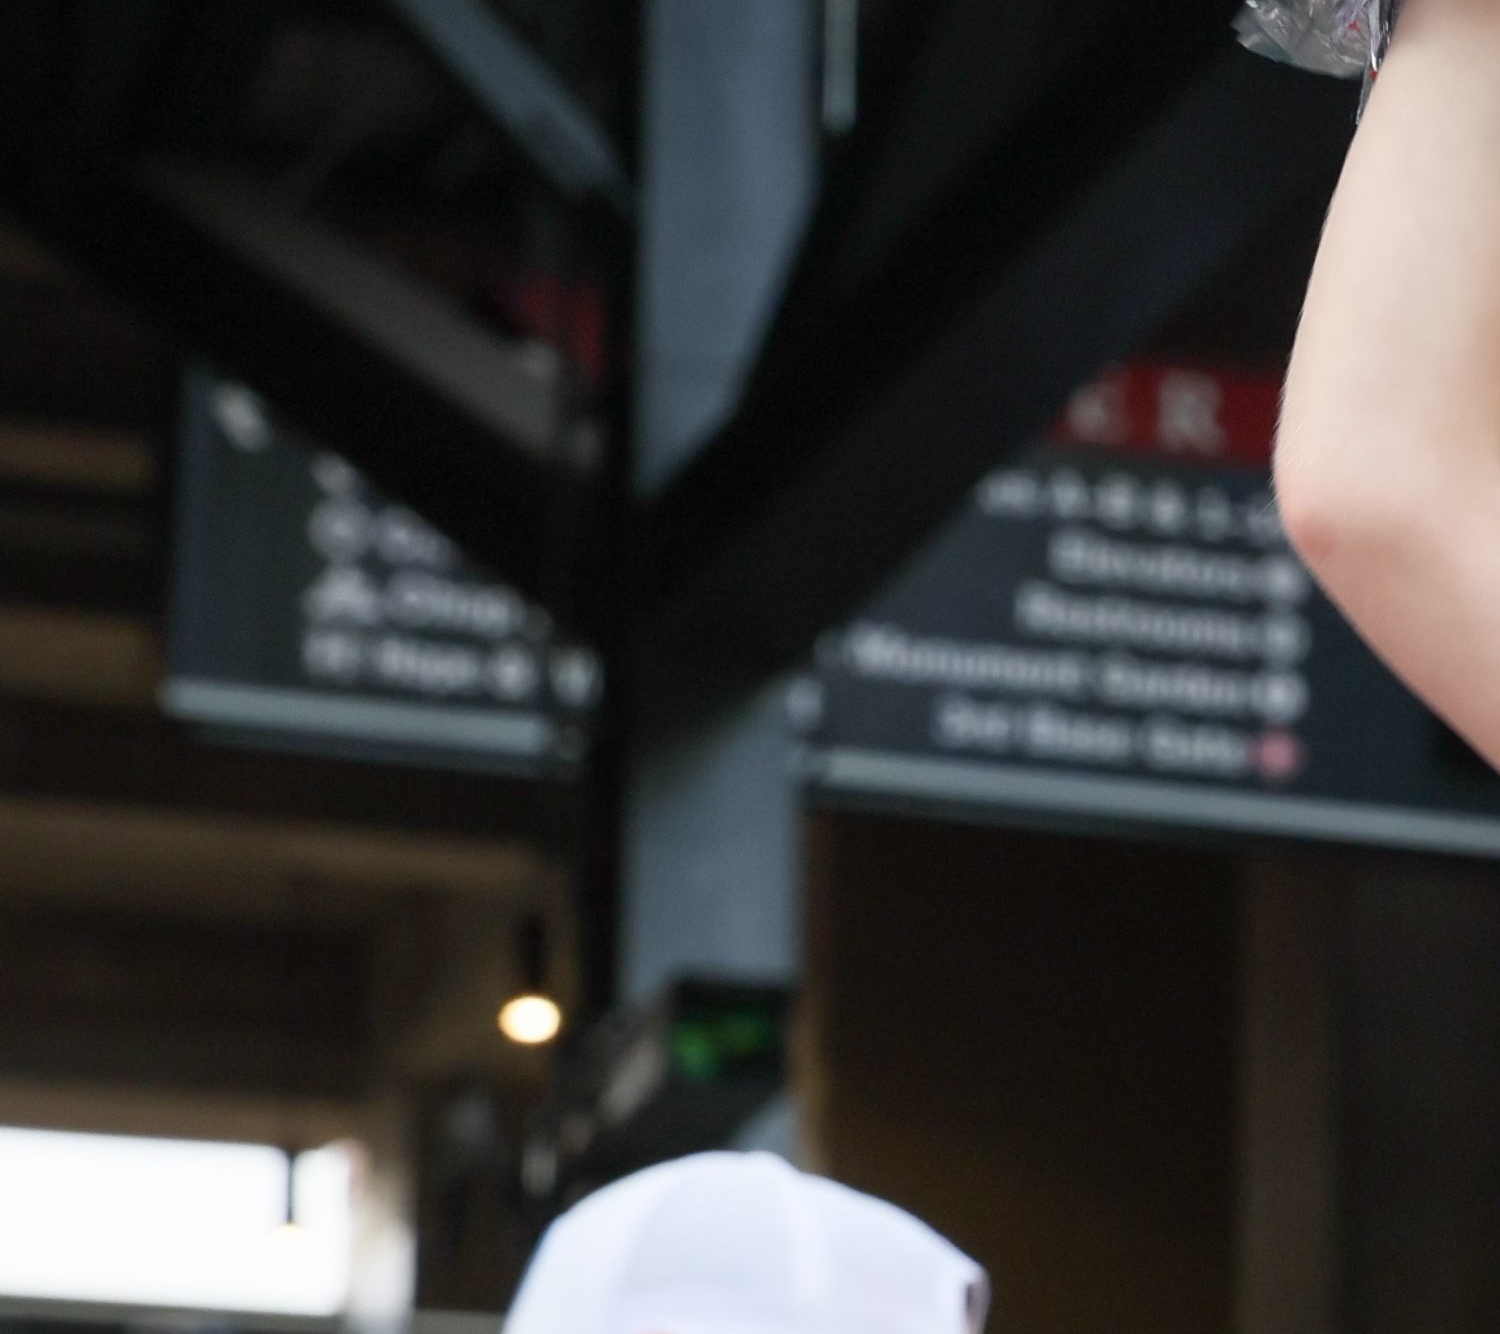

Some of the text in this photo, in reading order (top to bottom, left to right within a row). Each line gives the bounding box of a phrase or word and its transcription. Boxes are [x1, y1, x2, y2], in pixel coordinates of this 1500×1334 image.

[1050, 529, 1258, 603] Elevators
[1016, 581, 1256, 659] Restrooms
[846, 622, 1254, 715] Monument Garden
[1018, 704, 1138, 764] Base
